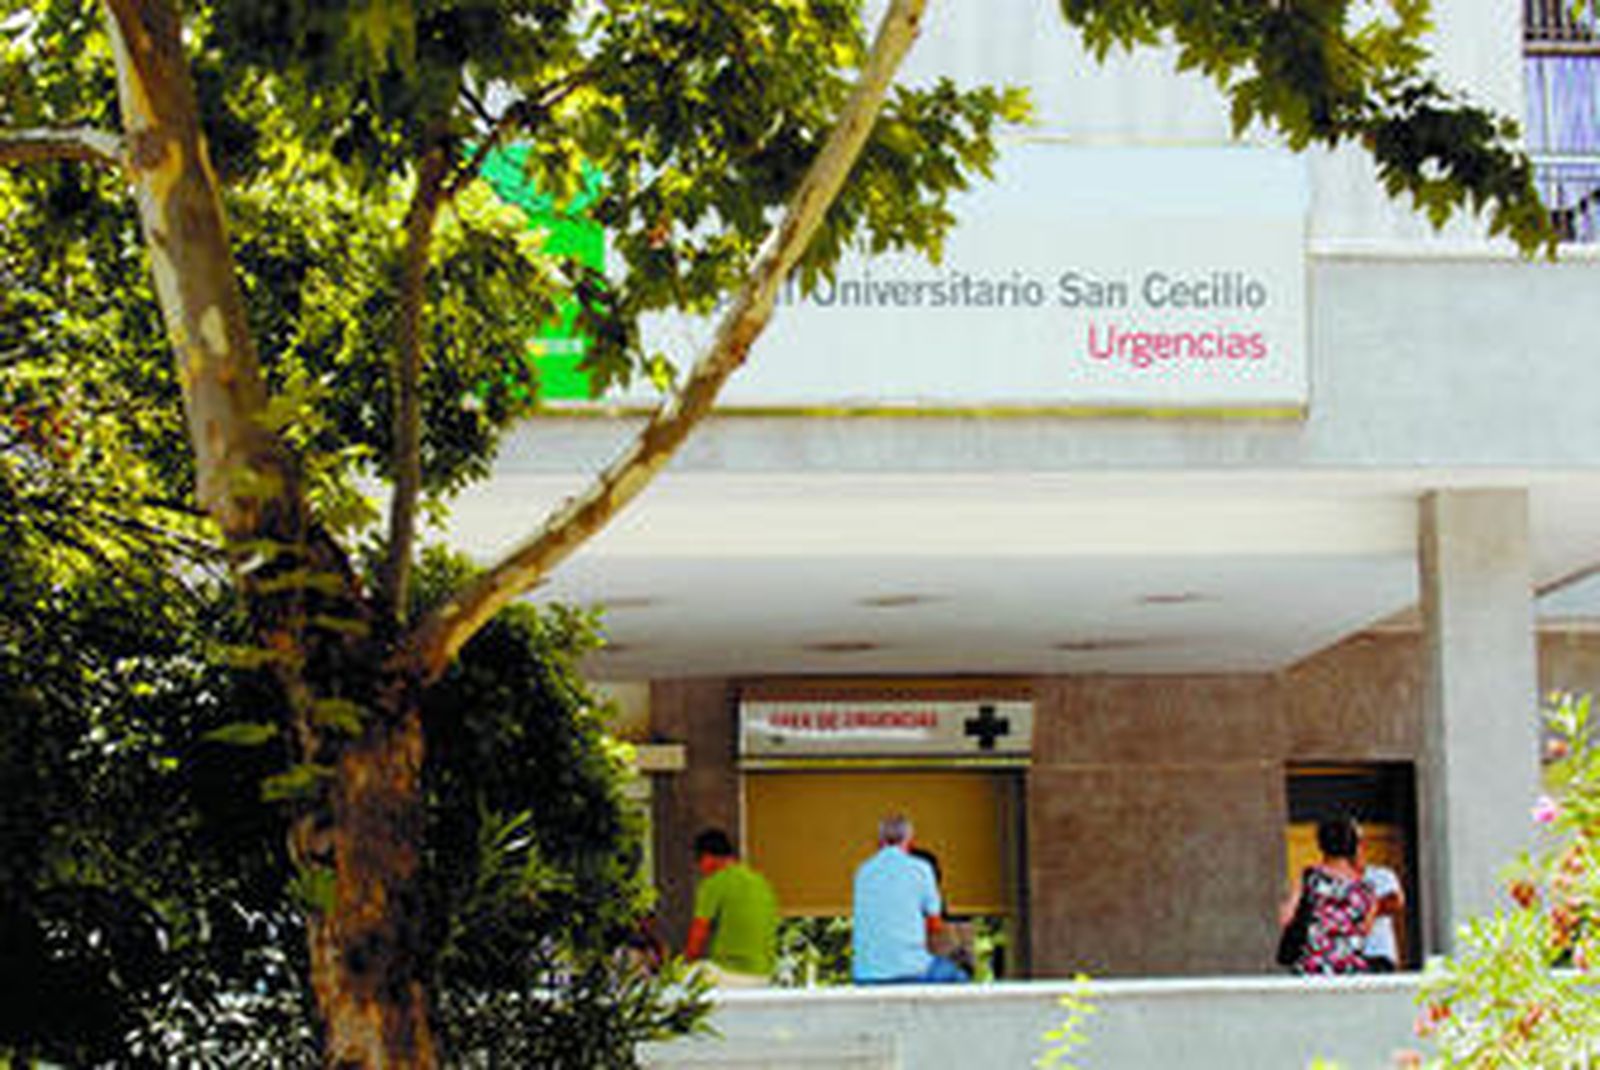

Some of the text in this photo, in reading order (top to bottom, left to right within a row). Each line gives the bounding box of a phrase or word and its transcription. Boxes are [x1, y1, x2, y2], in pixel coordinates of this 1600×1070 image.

[1058, 271, 1128, 308] San
[1142, 271, 1267, 309] Cecilio
[1086, 320, 1268, 368] Urgencias
